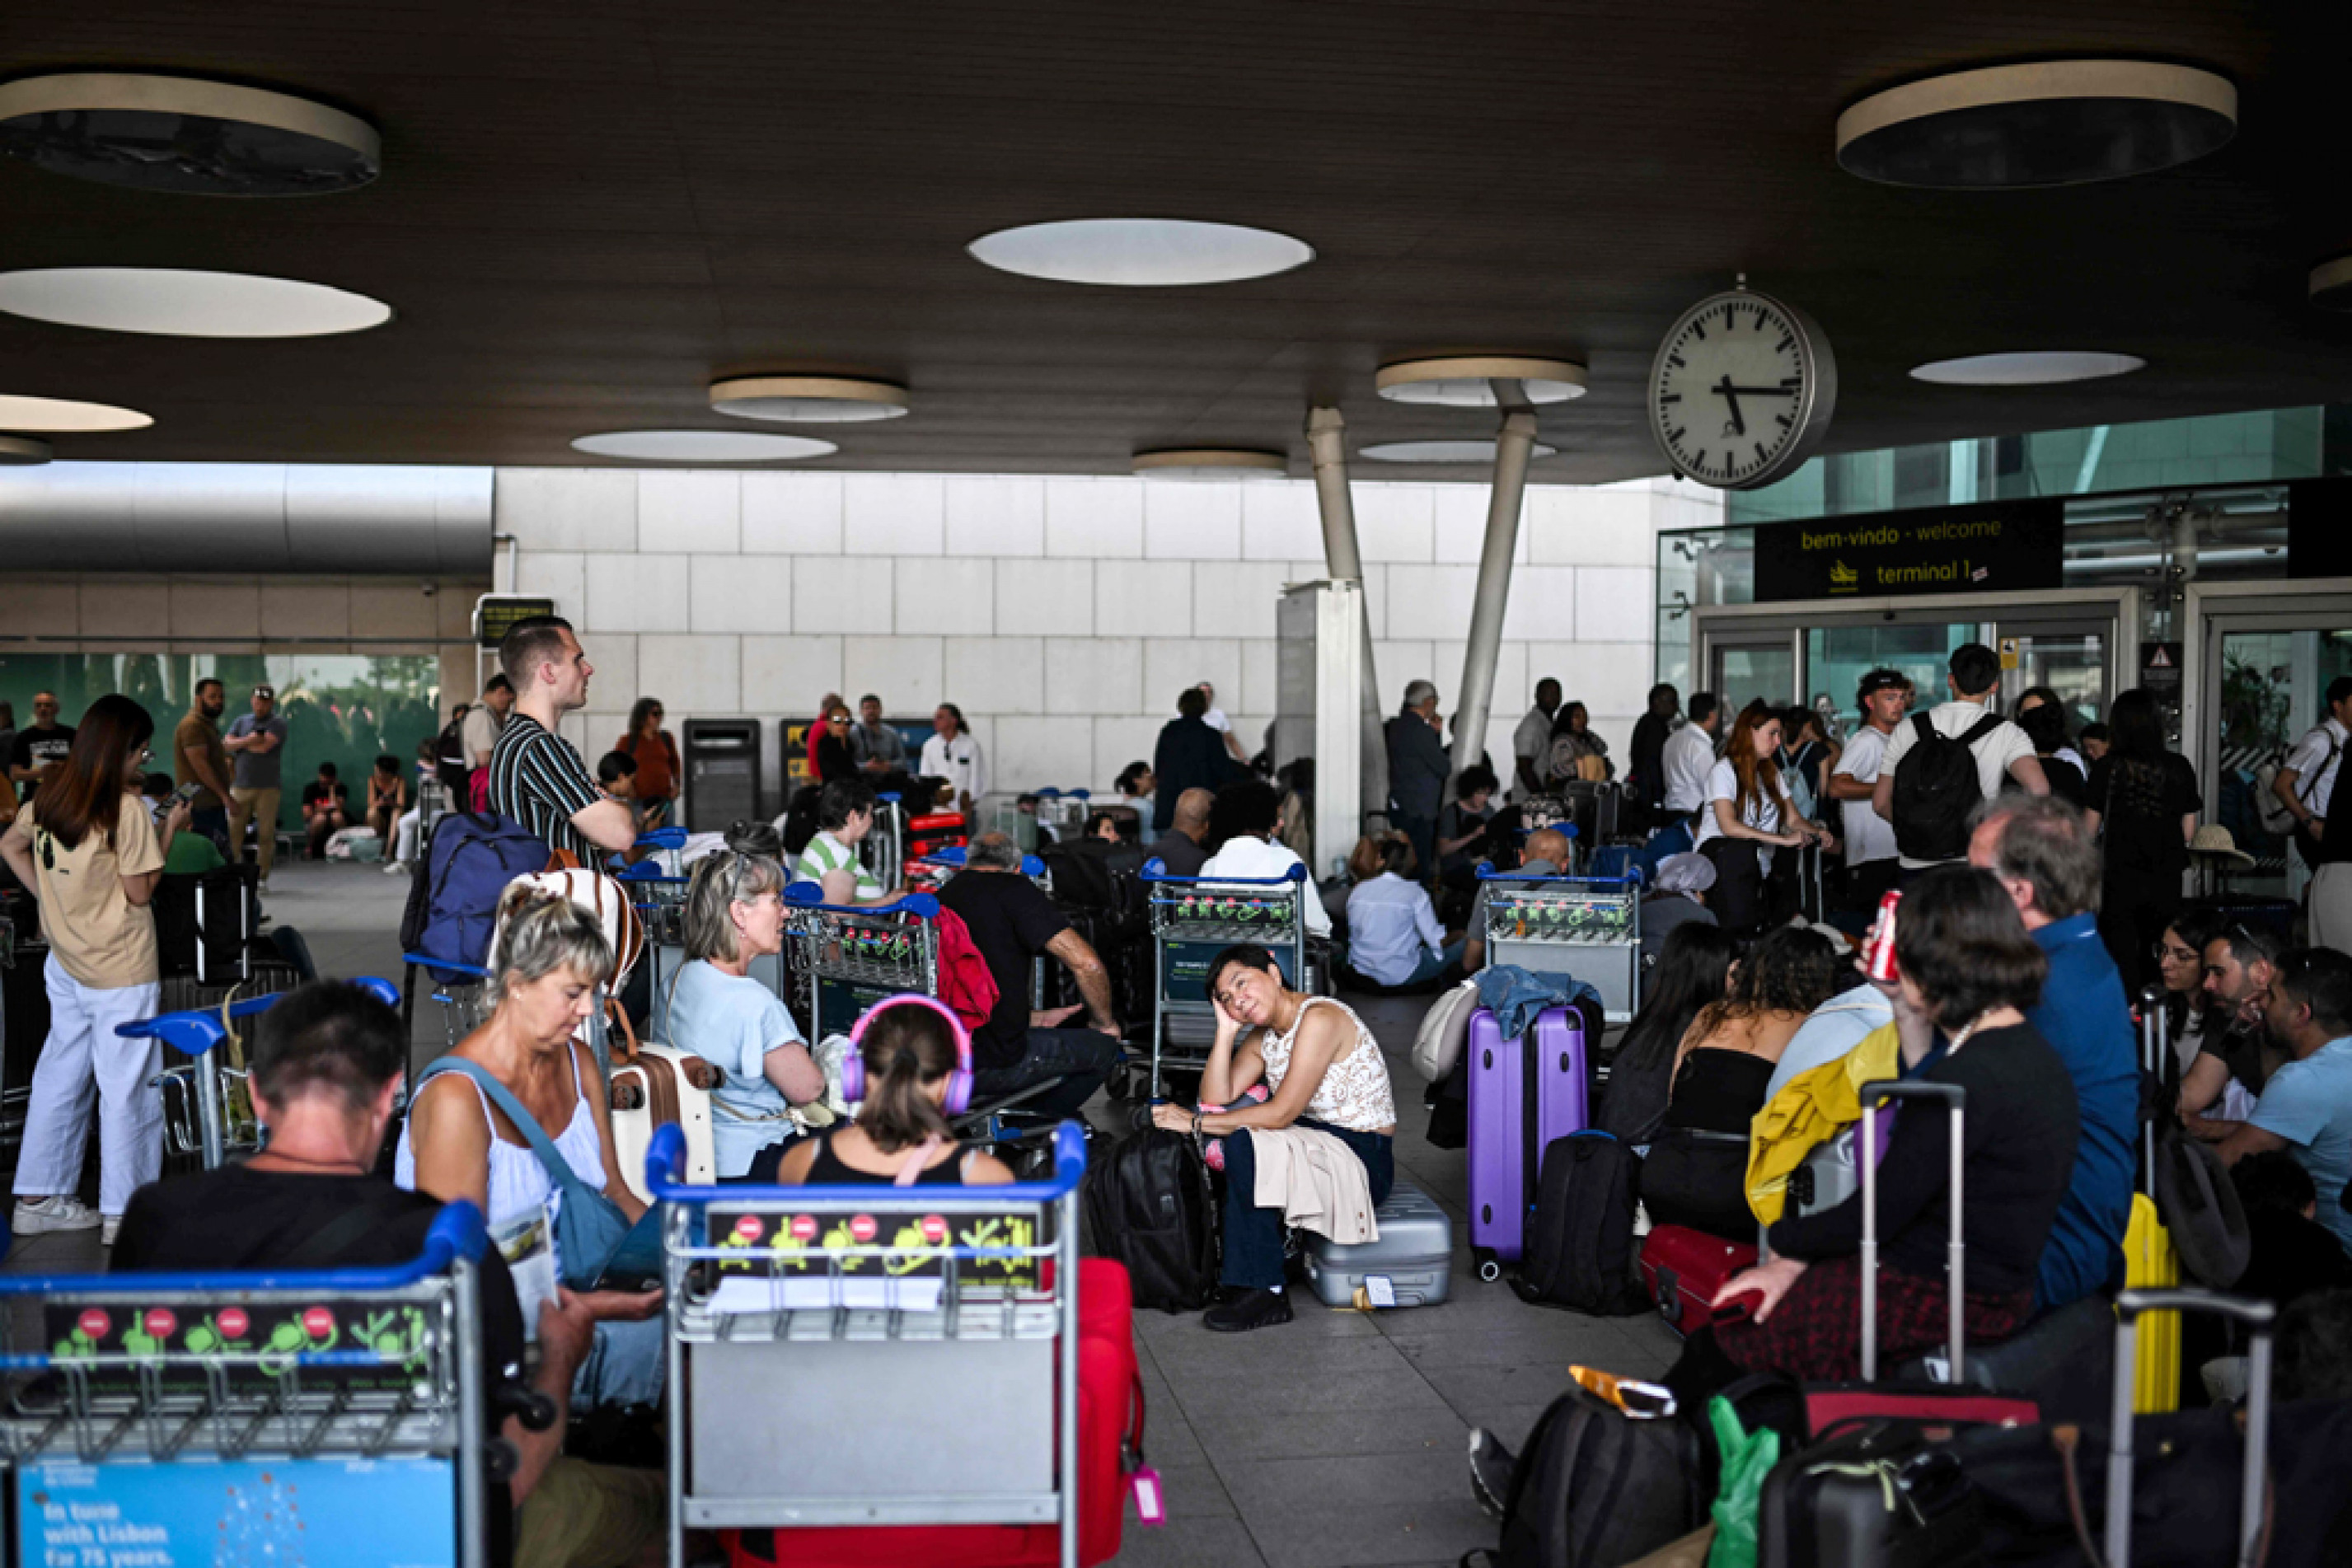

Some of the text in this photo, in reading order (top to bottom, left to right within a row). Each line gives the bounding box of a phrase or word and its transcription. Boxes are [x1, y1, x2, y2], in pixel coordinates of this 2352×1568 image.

[1801, 525, 1900, 550] bem-vindo
[1917, 520, 2002, 541] welcome
[1876, 559, 1970, 584] terminal 1
[44, 1501, 119, 1520] In tune
[45, 1523, 168, 1544] with Lisbon
[82, 1547, 107, 1566] 75
